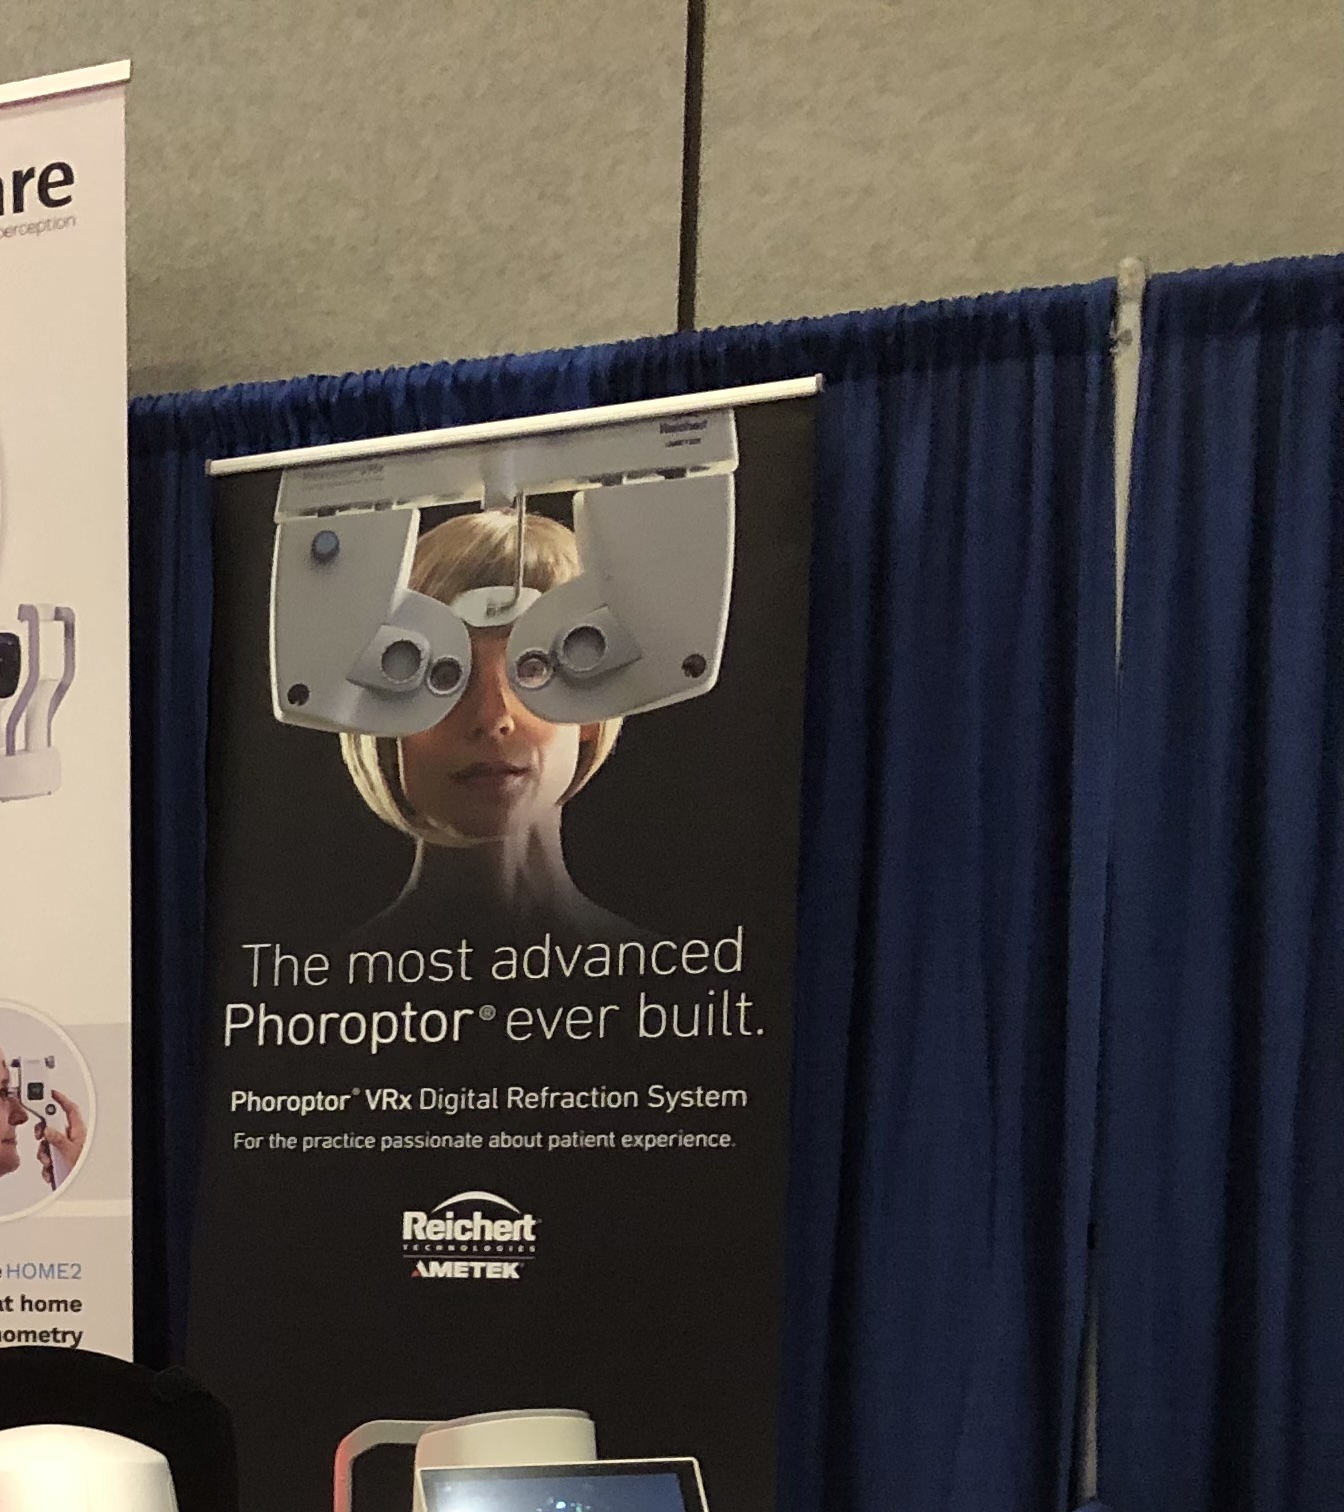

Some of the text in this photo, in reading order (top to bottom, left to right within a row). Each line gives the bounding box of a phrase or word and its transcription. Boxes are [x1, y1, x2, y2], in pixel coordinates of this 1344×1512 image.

[242, 925, 744, 988] The most advanced
[505, 1002, 620, 1041] ever
[637, 989, 765, 1039] built.
[365, 1088, 412, 1111] VRx
[419, 1087, 497, 1115] Digital
[507, 1085, 639, 1109] Refraction
[647, 1084, 747, 1113] System
[234, 1129, 736, 1152] For the practice passionate about patient experience.
[402, 1211, 536, 1241] Reichert
[6, 1262, 82, 1280] HOME2
[411, 1259, 520, 1279] AMETEK
[20, 1294, 83, 1312] home
